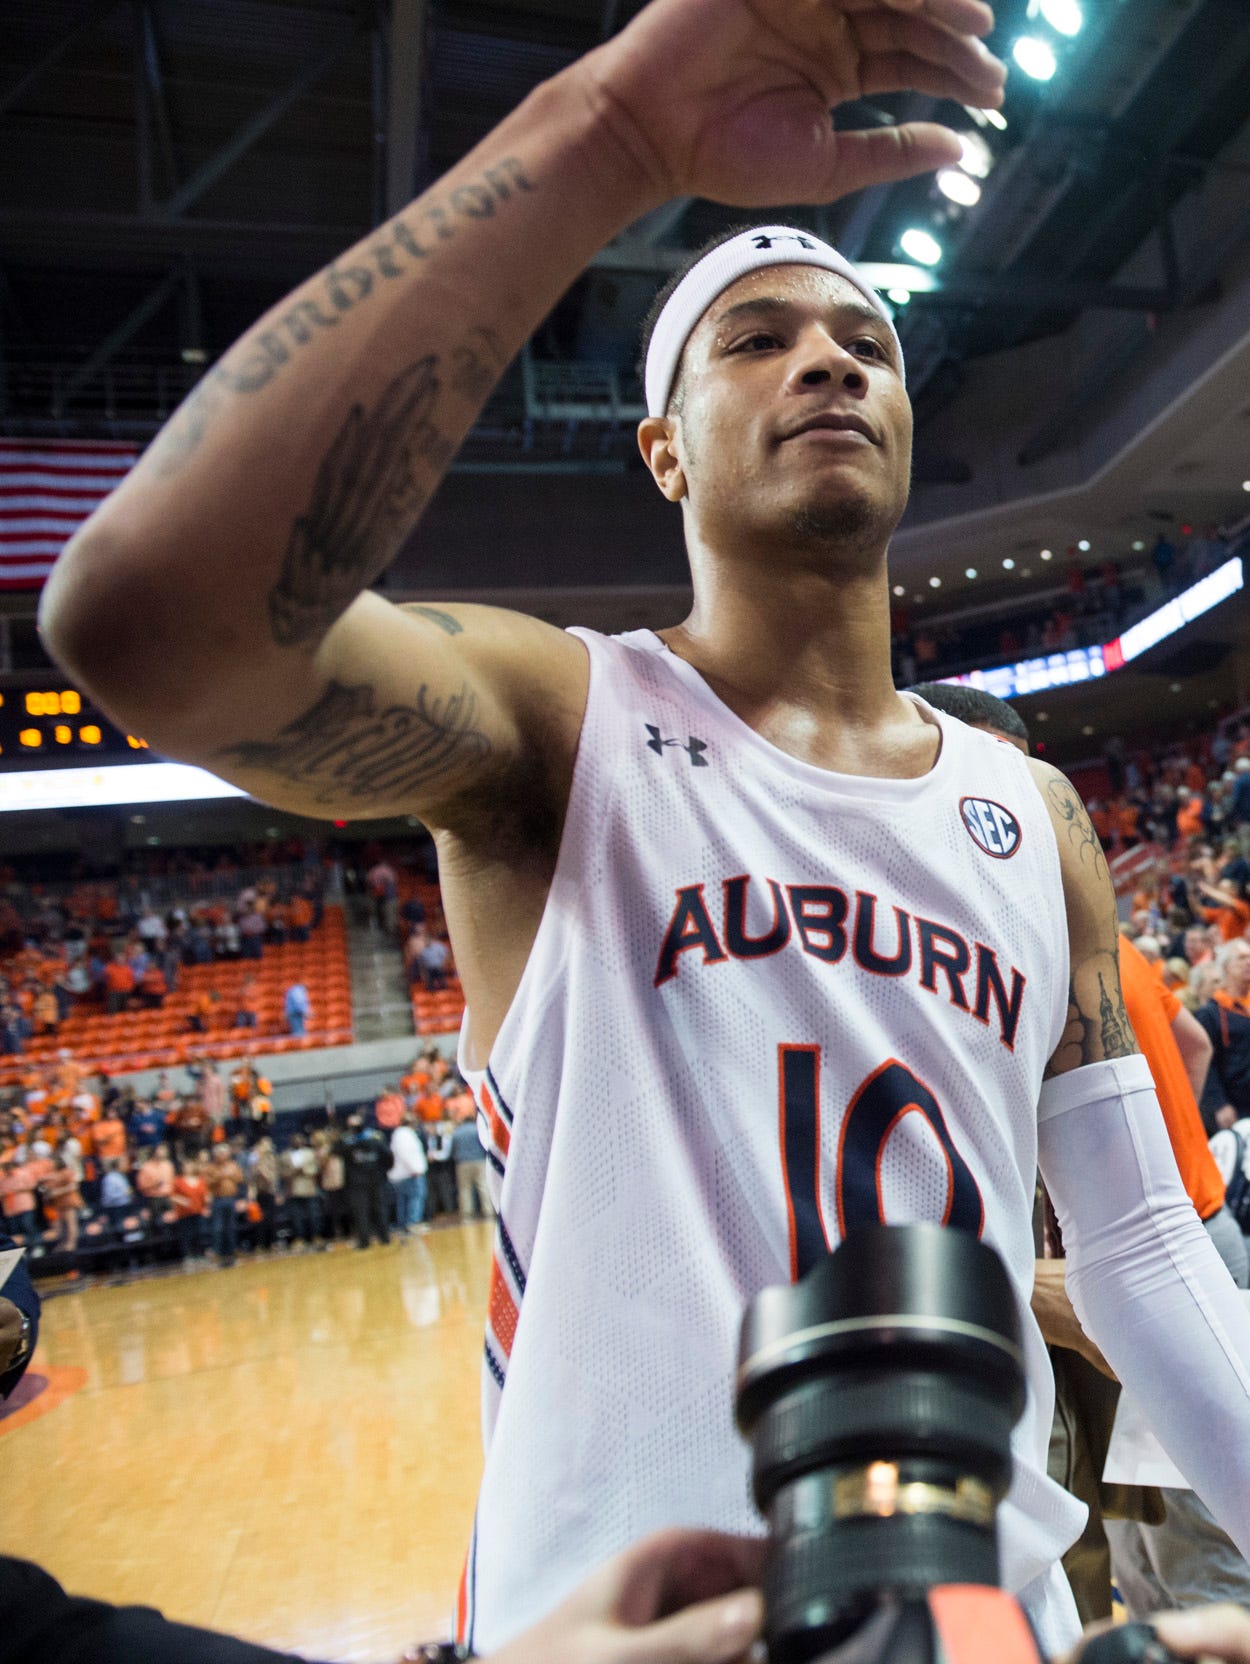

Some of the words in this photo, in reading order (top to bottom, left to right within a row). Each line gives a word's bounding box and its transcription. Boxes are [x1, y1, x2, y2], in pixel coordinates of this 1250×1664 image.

[962, 799, 1018, 855] SEC
[654, 874, 1026, 1053] AUBURN
[777, 1042, 985, 1287] 10
